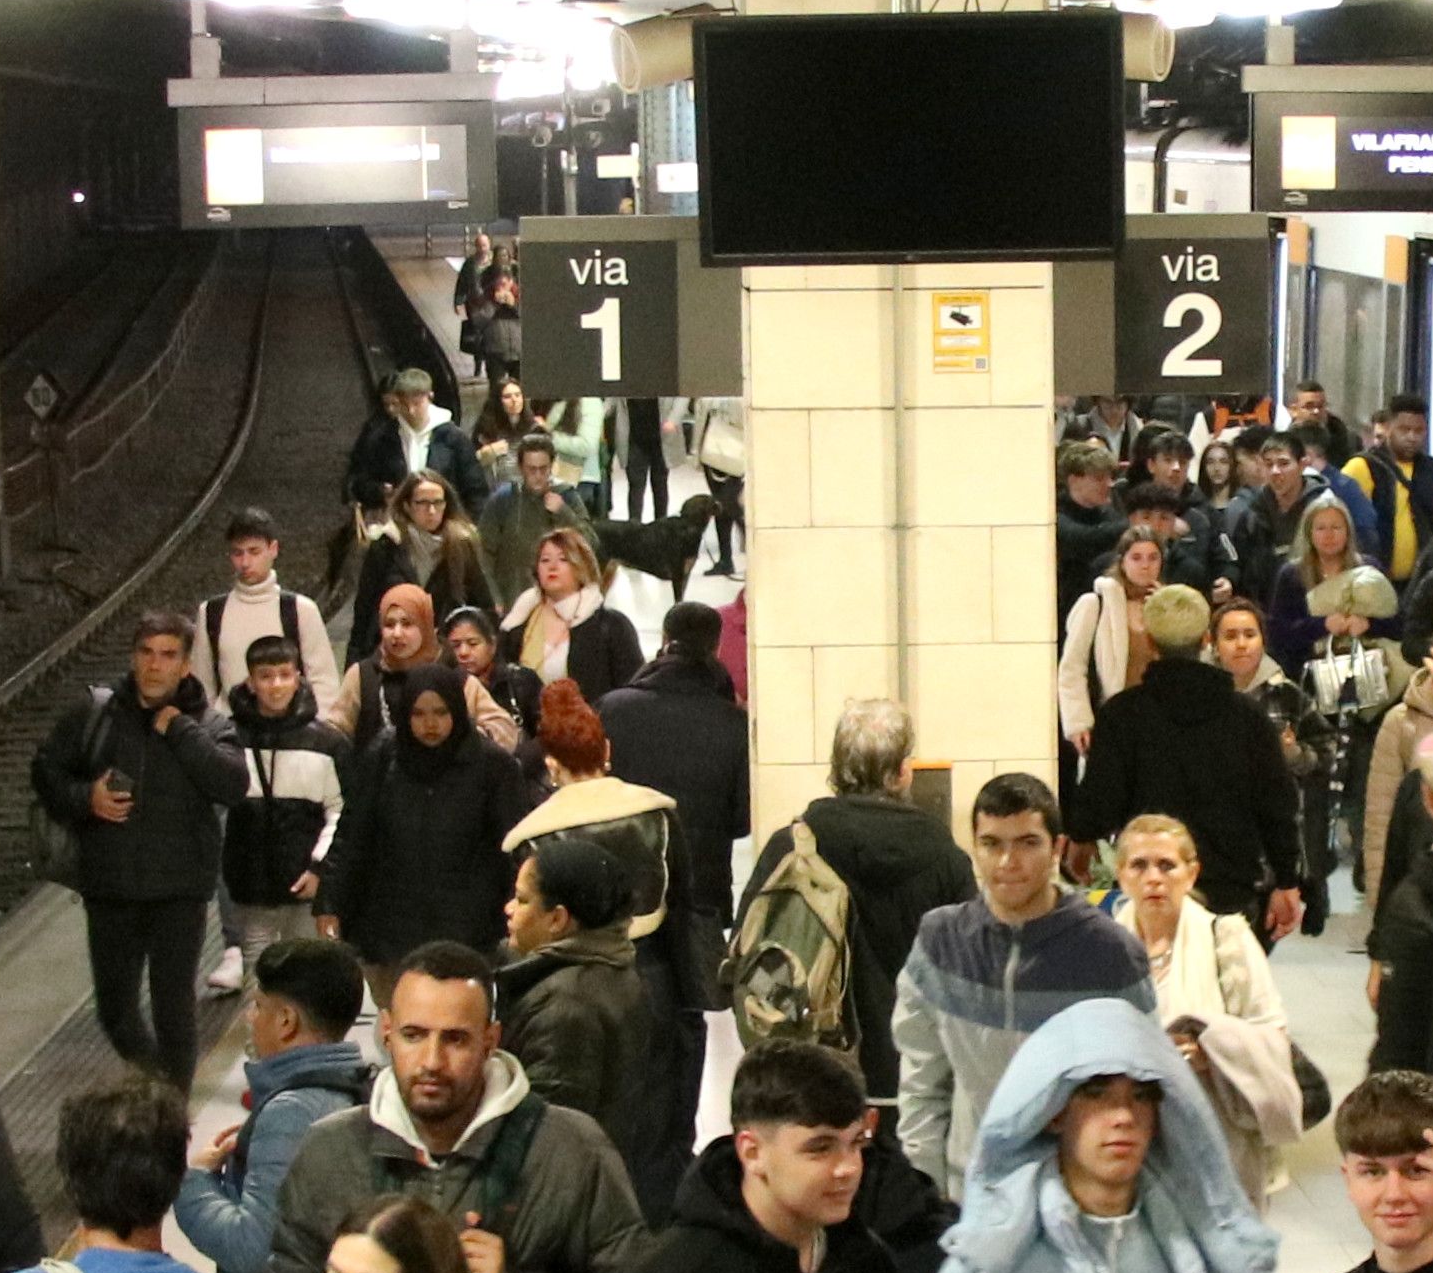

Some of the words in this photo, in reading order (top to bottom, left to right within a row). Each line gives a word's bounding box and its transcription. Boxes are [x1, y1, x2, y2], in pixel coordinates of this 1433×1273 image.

[569, 249, 629, 286] via
[1161, 245, 1221, 283] via
[580, 296, 622, 382] 1
[1161, 291, 1223, 378] 2
